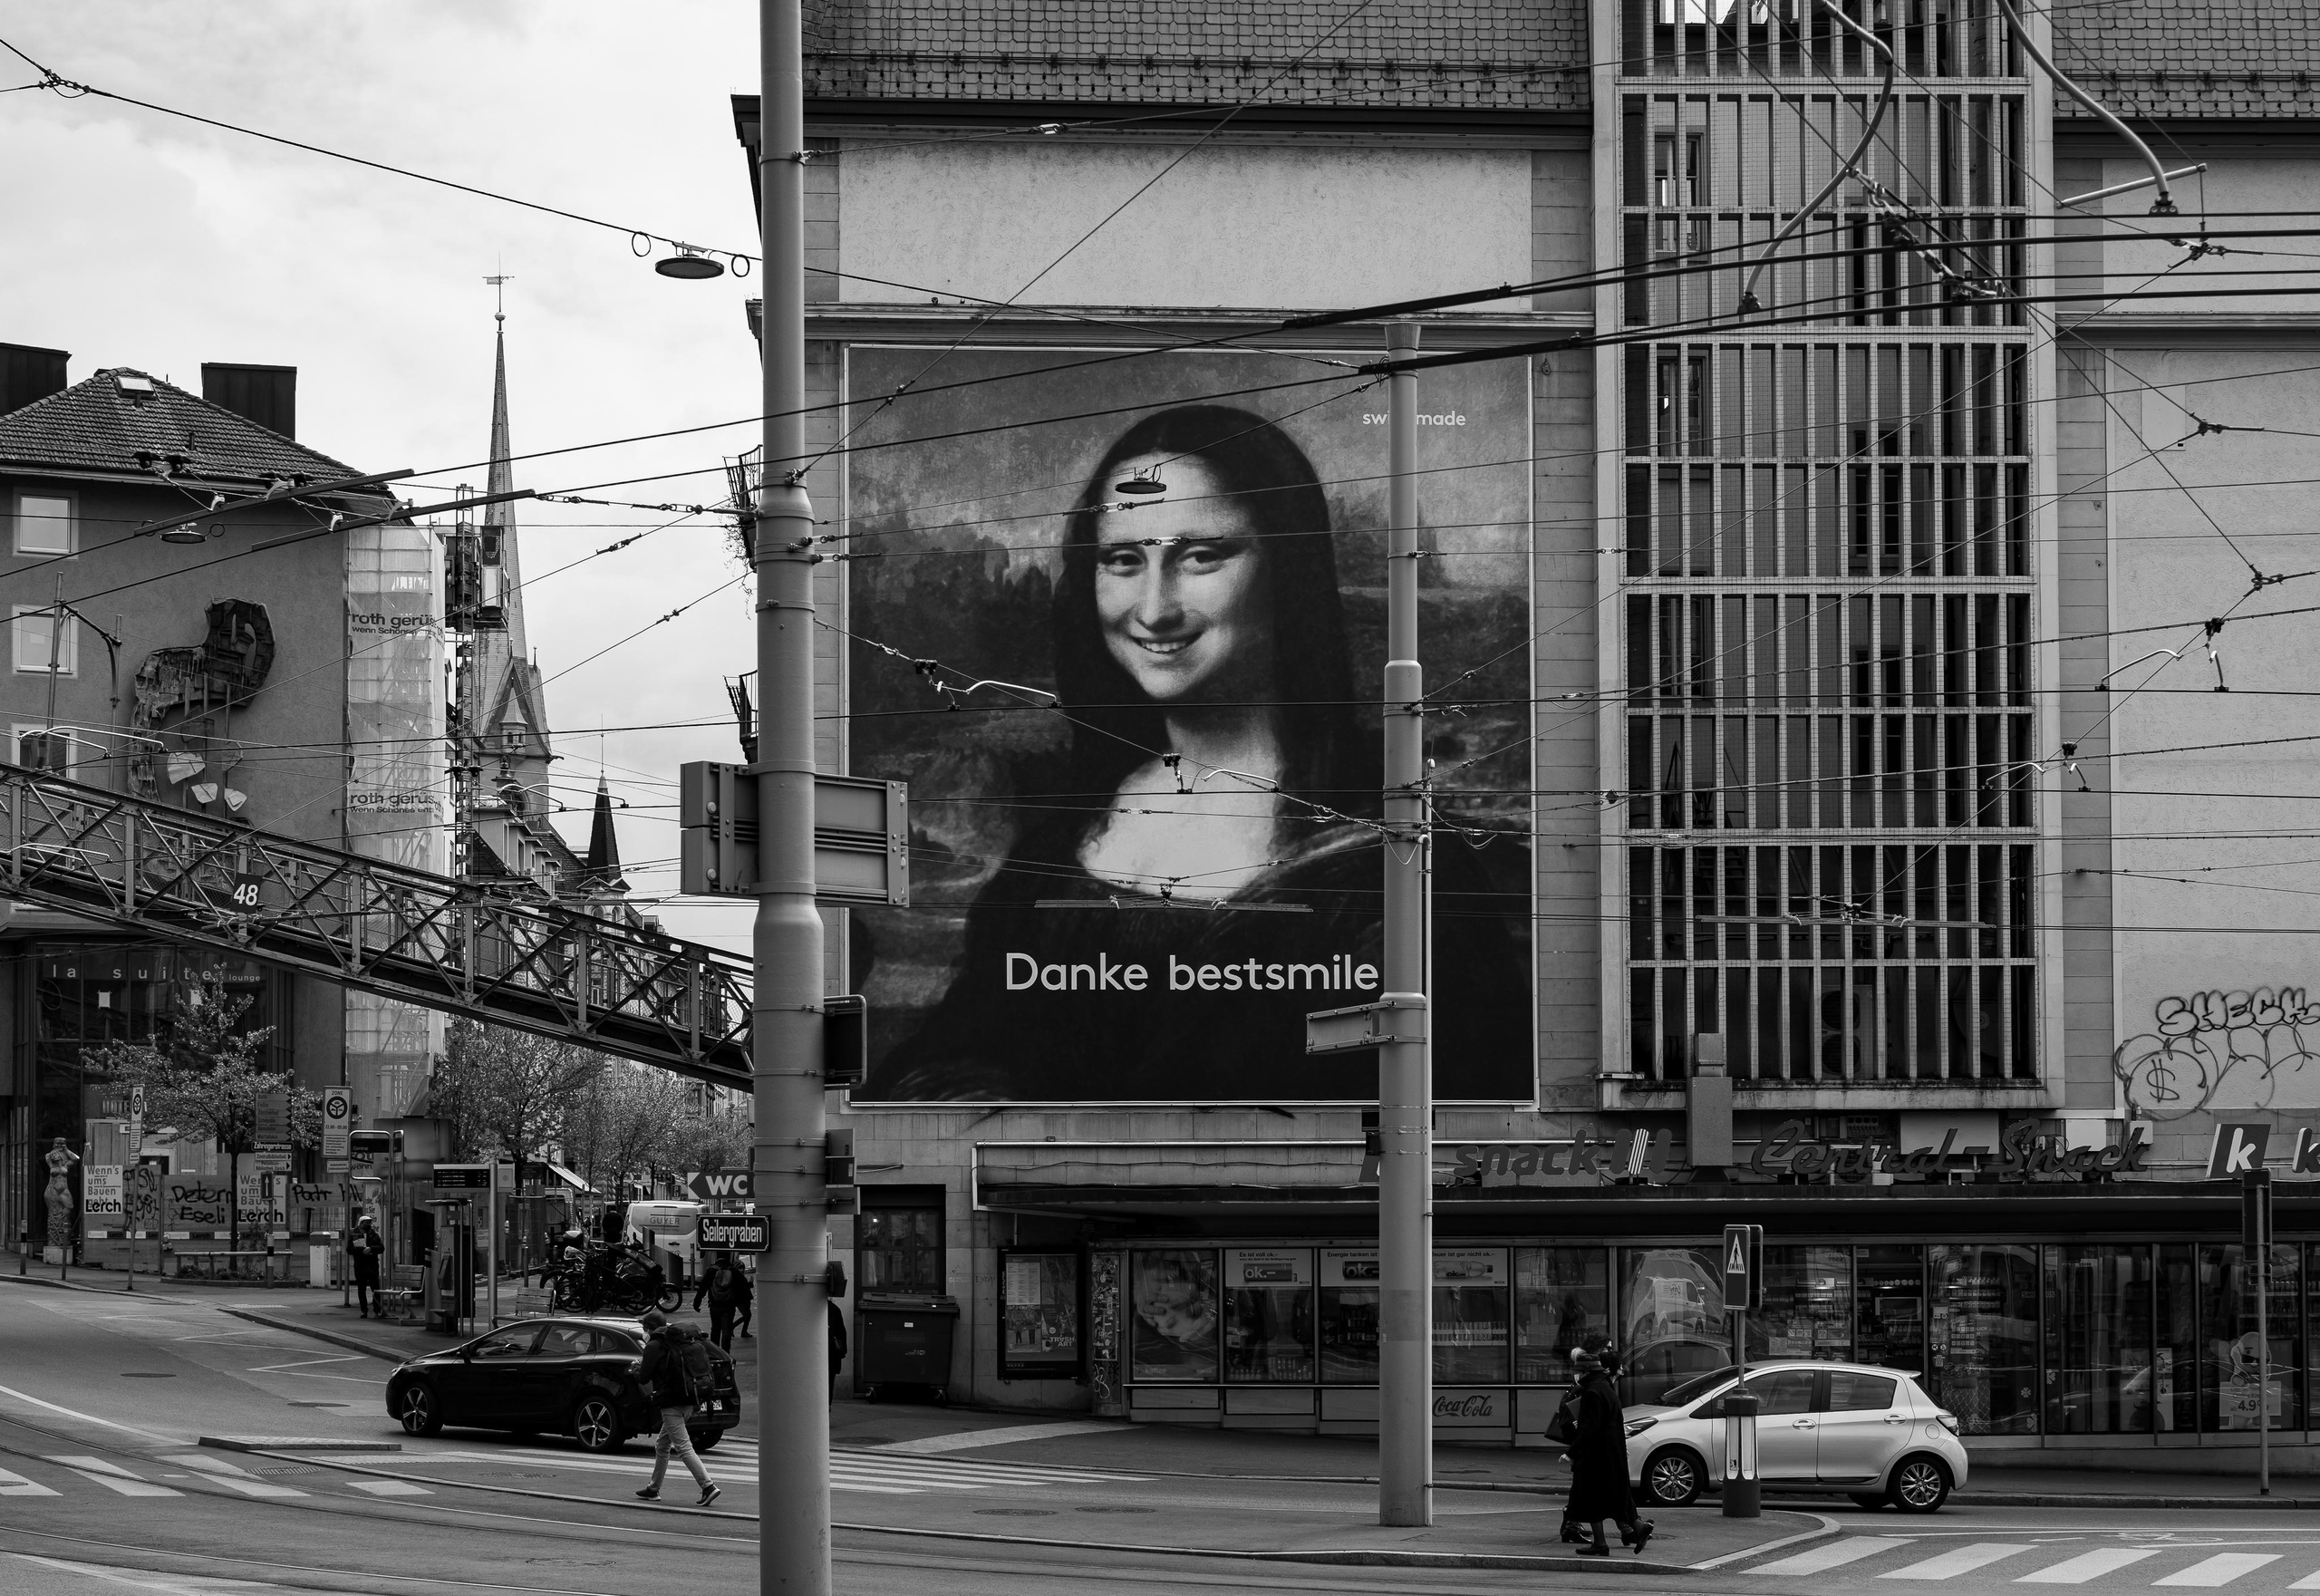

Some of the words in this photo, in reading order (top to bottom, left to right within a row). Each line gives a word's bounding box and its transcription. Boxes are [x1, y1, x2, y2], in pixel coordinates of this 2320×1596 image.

[1416, 411, 1466, 426] made
[352, 614, 385, 624] roth
[350, 792, 384, 804] roth
[233, 883, 259, 906] 48
[53, 964, 76, 978] la
[112, 966, 212, 980] suite
[228, 973, 261, 982] lounge
[1006, 952, 1149, 991] Danke
[1169, 953, 1379, 991] bestsmile
[1454, 1128, 1601, 1176] snack
[87, 1165, 120, 1175] Wenn's
[88, 1185, 116, 1195] Bauen
[705, 1174, 748, 1195] WC
[85, 1198, 121, 1213] Lerch
[237, 1208, 284, 1223] Lerch
[650, 1216, 681, 1225] GUYER
[702, 1218, 762, 1248] Seilergraben
[1432, 1395, 1494, 1417] Coca-Cola
